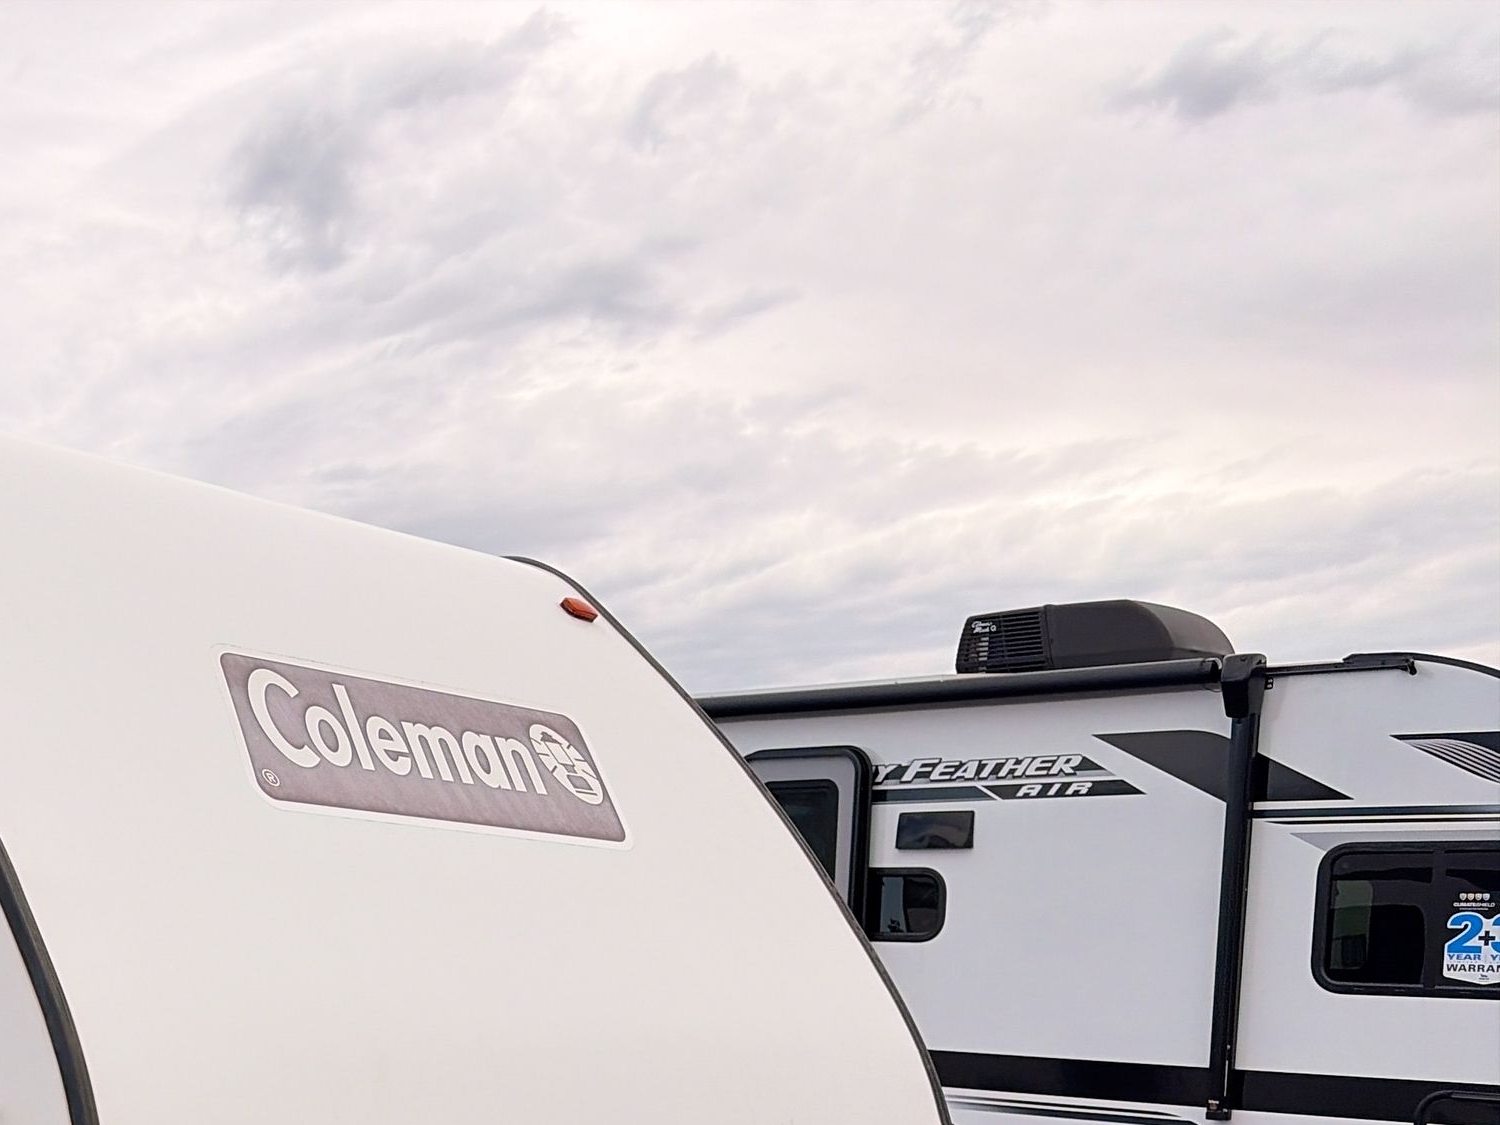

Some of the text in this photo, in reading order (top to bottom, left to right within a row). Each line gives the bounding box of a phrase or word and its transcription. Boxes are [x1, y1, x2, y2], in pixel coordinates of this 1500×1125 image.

[247, 668, 548, 795] Coleman
[900, 754, 1085, 783] FEATHER
[1016, 781, 1093, 797] AIR
